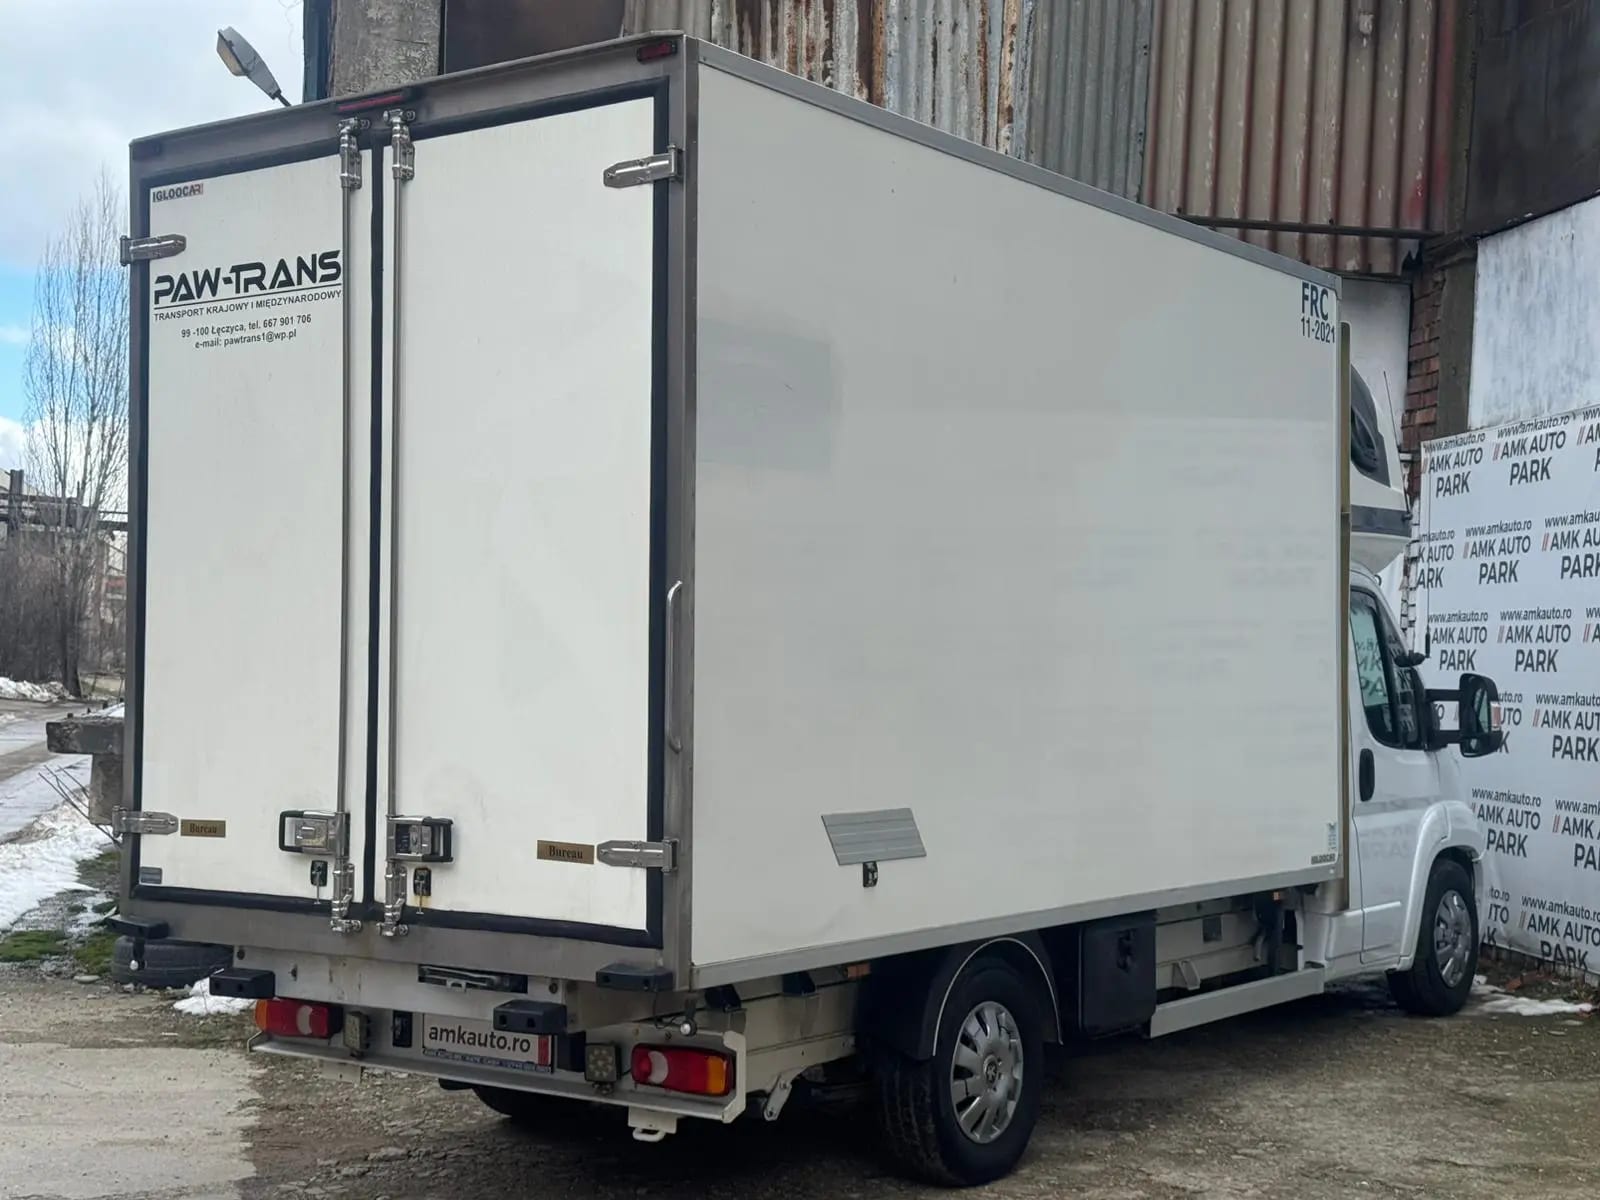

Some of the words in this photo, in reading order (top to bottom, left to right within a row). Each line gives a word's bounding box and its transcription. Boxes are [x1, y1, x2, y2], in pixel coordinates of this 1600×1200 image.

[152, 183, 203, 203] IGLOOCAR
[153, 250, 342, 305] PAW-TRANS
[154, 307, 204, 321] TRANSPORT
[206, 302, 250, 315] KRAJOWY
[251, 301, 254, 309] I
[256, 290, 342, 309] MIĘDZYNARODOWY
[1302, 281, 1328, 321] FRC
[181, 329, 191, 338] 99
[211, 322, 247, 337] Łęczyca,
[248, 320, 261, 330] tel.
[263, 318, 277, 329] 667
[279, 316, 294, 327] 901
[296, 314, 312, 325] 706
[1301, 316, 1335, 343] 11-2021
[195, 338, 222, 348] e-mail:
[224, 329, 297, 348] pawtrans1@wp.pl
[1500, 437, 1529, 460] AMK
[1529, 430, 1566, 452] AUTO
[1428, 453, 1453, 474] AMK
[1453, 447, 1483, 469] AUTO
[1509, 456, 1552, 486] PARK
[1436, 471, 1471, 498] PARK
[1465, 519, 1532, 538] www.amkauto.ro
[1550, 529, 1580, 550] AMK
[1427, 543, 1454, 563] AUTO
[1470, 538, 1498, 559] AMK
[1497, 535, 1531, 556] AUTO
[1416, 566, 1444, 590] ARK
[1478, 560, 1519, 585] PARK
[1428, 609, 1488, 623] www.amkauto.ro
[1500, 606, 1572, 621] www.amkauto.ro
[1432, 627, 1455, 644] AMK
[1456, 626, 1488, 645] AUTO
[1505, 626, 1533, 644] AMK
[1536, 624, 1571, 644] AUTO
[1439, 649, 1476, 671] PARK
[1514, 649, 1559, 673] PARK
[1500, 707, 1522, 726] UTO
[1541, 709, 1572, 729] AMK
[1574, 711, 1600, 731] AUT
[1552, 734, 1600, 763] PARK
[1471, 788, 1542, 807] www.amkauto.ro
[189, 822, 217, 834] Bureau
[1477, 803, 1504, 826] AMK
[1506, 808, 1541, 830] AUTO
[1561, 816, 1594, 839] AMK
[549, 845, 583, 859] Bureau
[1486, 828, 1528, 858] PARK
[1574, 843, 1600, 872] PA
[1527, 912, 1560, 938] AMK
[1563, 920, 1600, 946] AUTO
[1538, 940, 1588, 971] PARK
[429, 1026, 531, 1053] amkauto.ro
